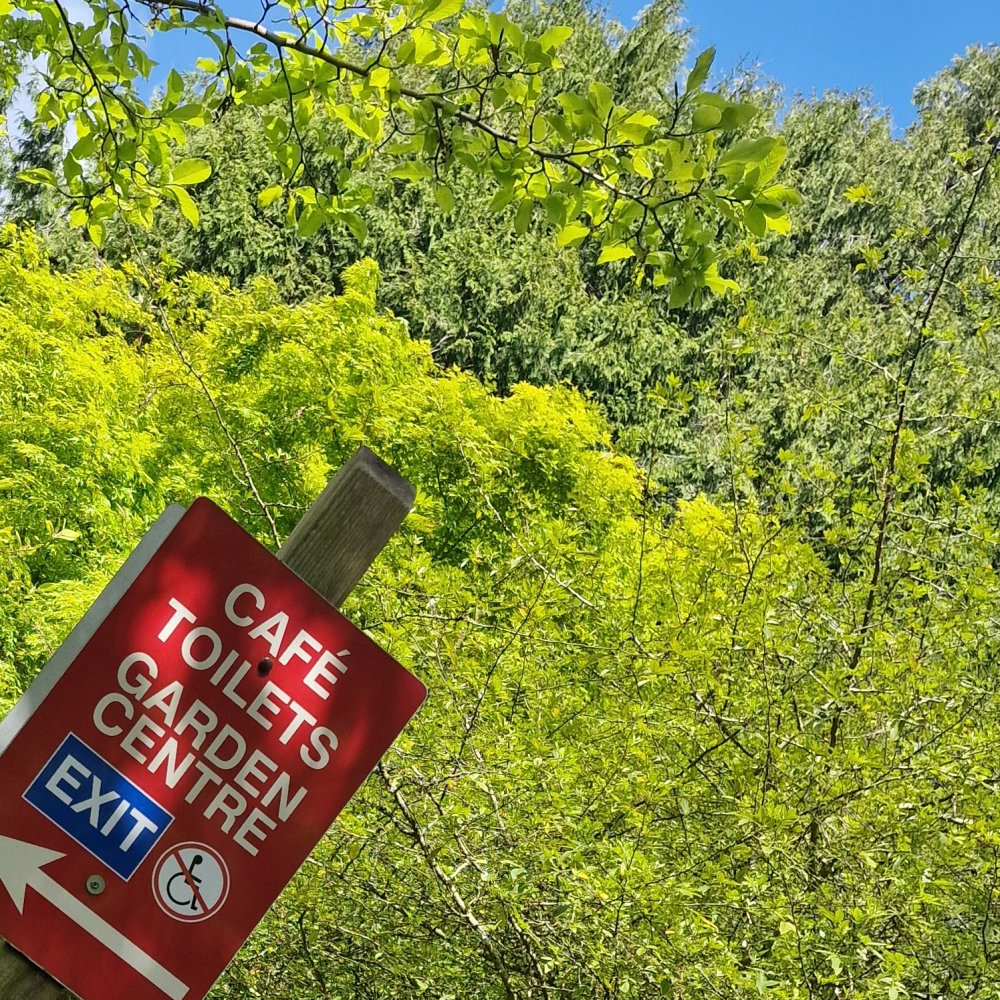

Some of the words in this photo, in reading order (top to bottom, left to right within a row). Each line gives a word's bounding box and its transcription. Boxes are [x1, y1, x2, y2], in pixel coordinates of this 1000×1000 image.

[157, 597, 338, 770] TOILETS
[225, 583, 351, 700] CAFÉ
[44, 755, 158, 852] EXIT
[93, 693, 277, 857] CENTRE
[117, 652, 308, 823] GARDEN
